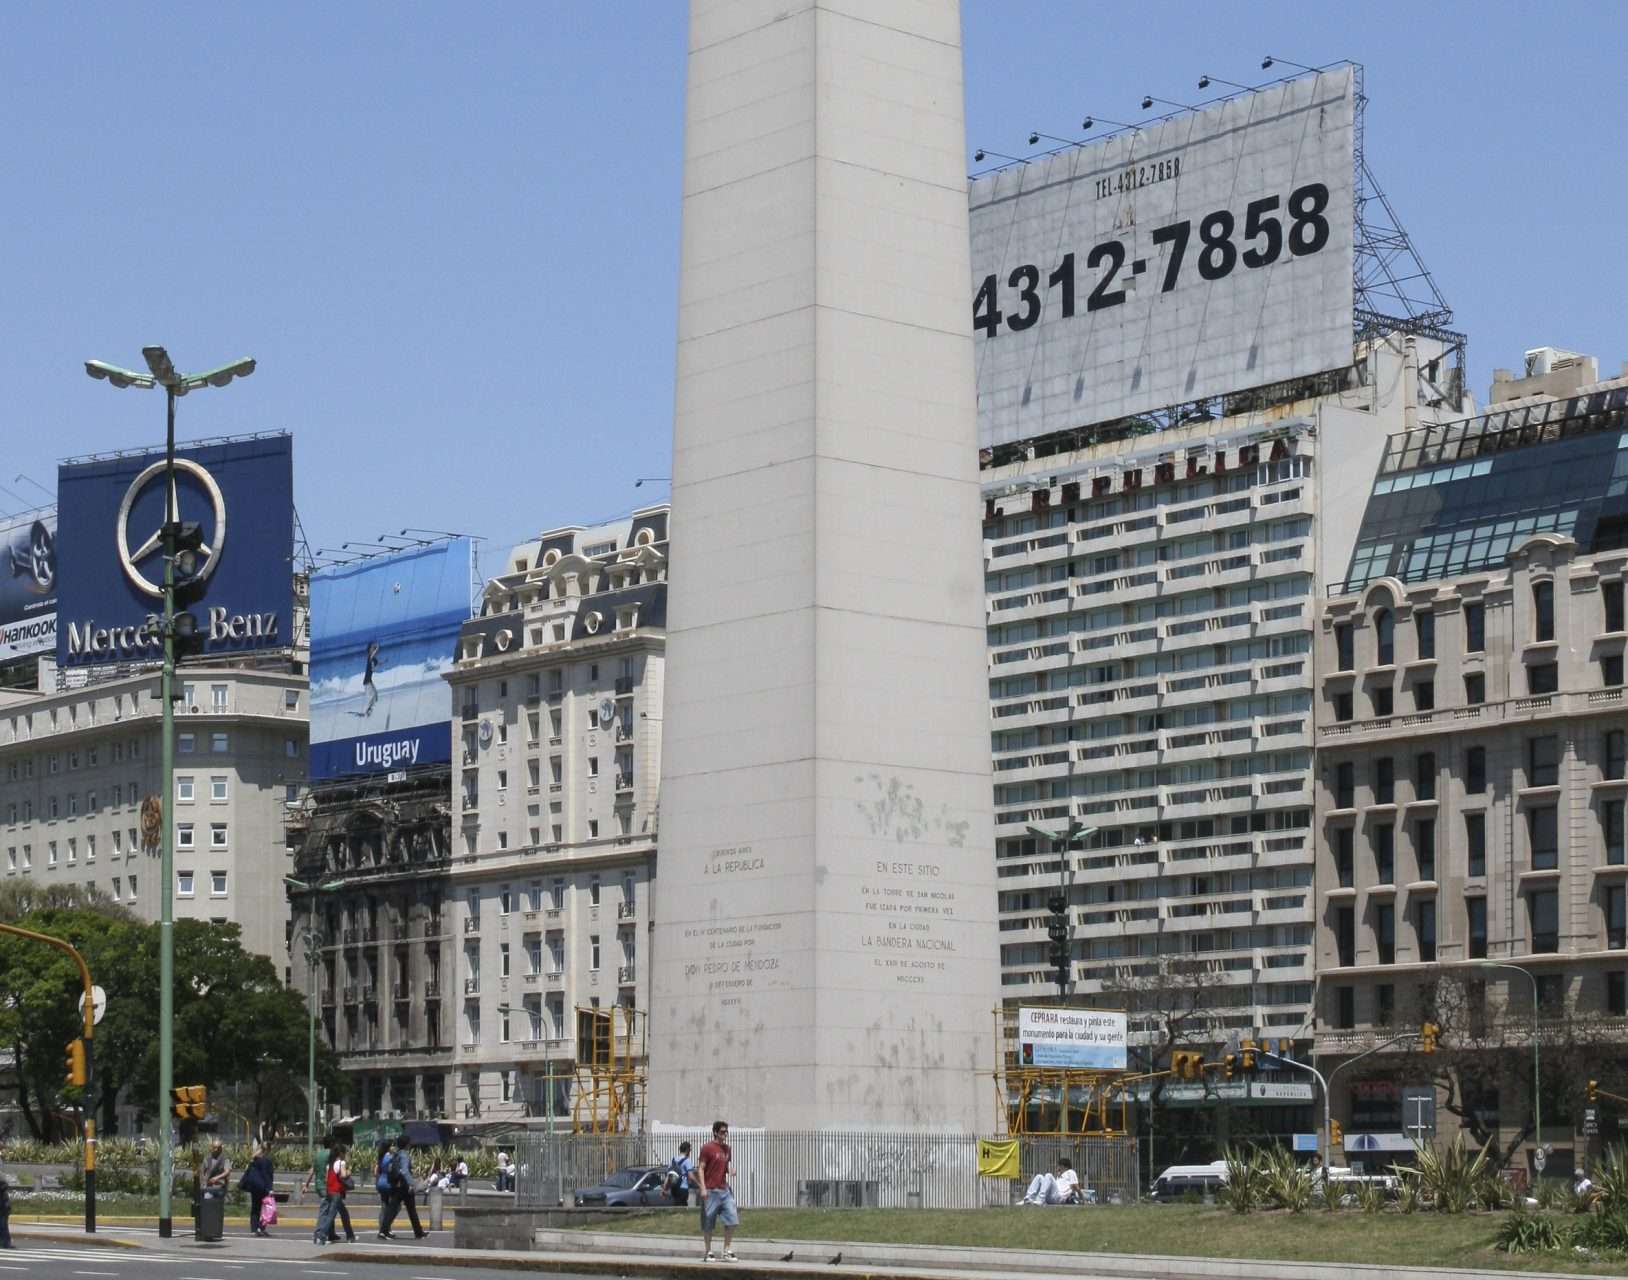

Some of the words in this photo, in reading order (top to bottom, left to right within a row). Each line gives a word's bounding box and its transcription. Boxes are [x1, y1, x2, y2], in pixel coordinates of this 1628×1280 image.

[972, 183, 1330, 338] 4312-7858
[208, 606, 278, 640] Benz
[356, 738, 419, 767] Uruguay
[713, 862, 721, 874] LA
[876, 861, 888, 873] EN
[892, 862, 913, 875] ESTE
[918, 864, 940, 877] SITIO
[862, 935, 873, 946] LA
[876, 936, 912, 949] BANDERA
[916, 938, 956, 951] NACIONAL
[704, 962, 728, 974] PEDRO
[731, 961, 741, 973] DE
[744, 957, 779, 970] MENDOZA
[1030, 1012, 1059, 1024] CEPRARA
[1060, 1016, 1083, 1025] restaura
[1088, 1017, 1101, 1028] pinta
[1103, 1018, 1116, 1027] este
[1022, 1029, 1055, 1039] monumento
[1056, 1031, 1068, 1040] para
[1068, 1029, 1074, 1039] la
[1075, 1031, 1093, 1040] ciudad
[1107, 1032, 1124, 1043] gente
[982, 1147, 990, 1158] H
